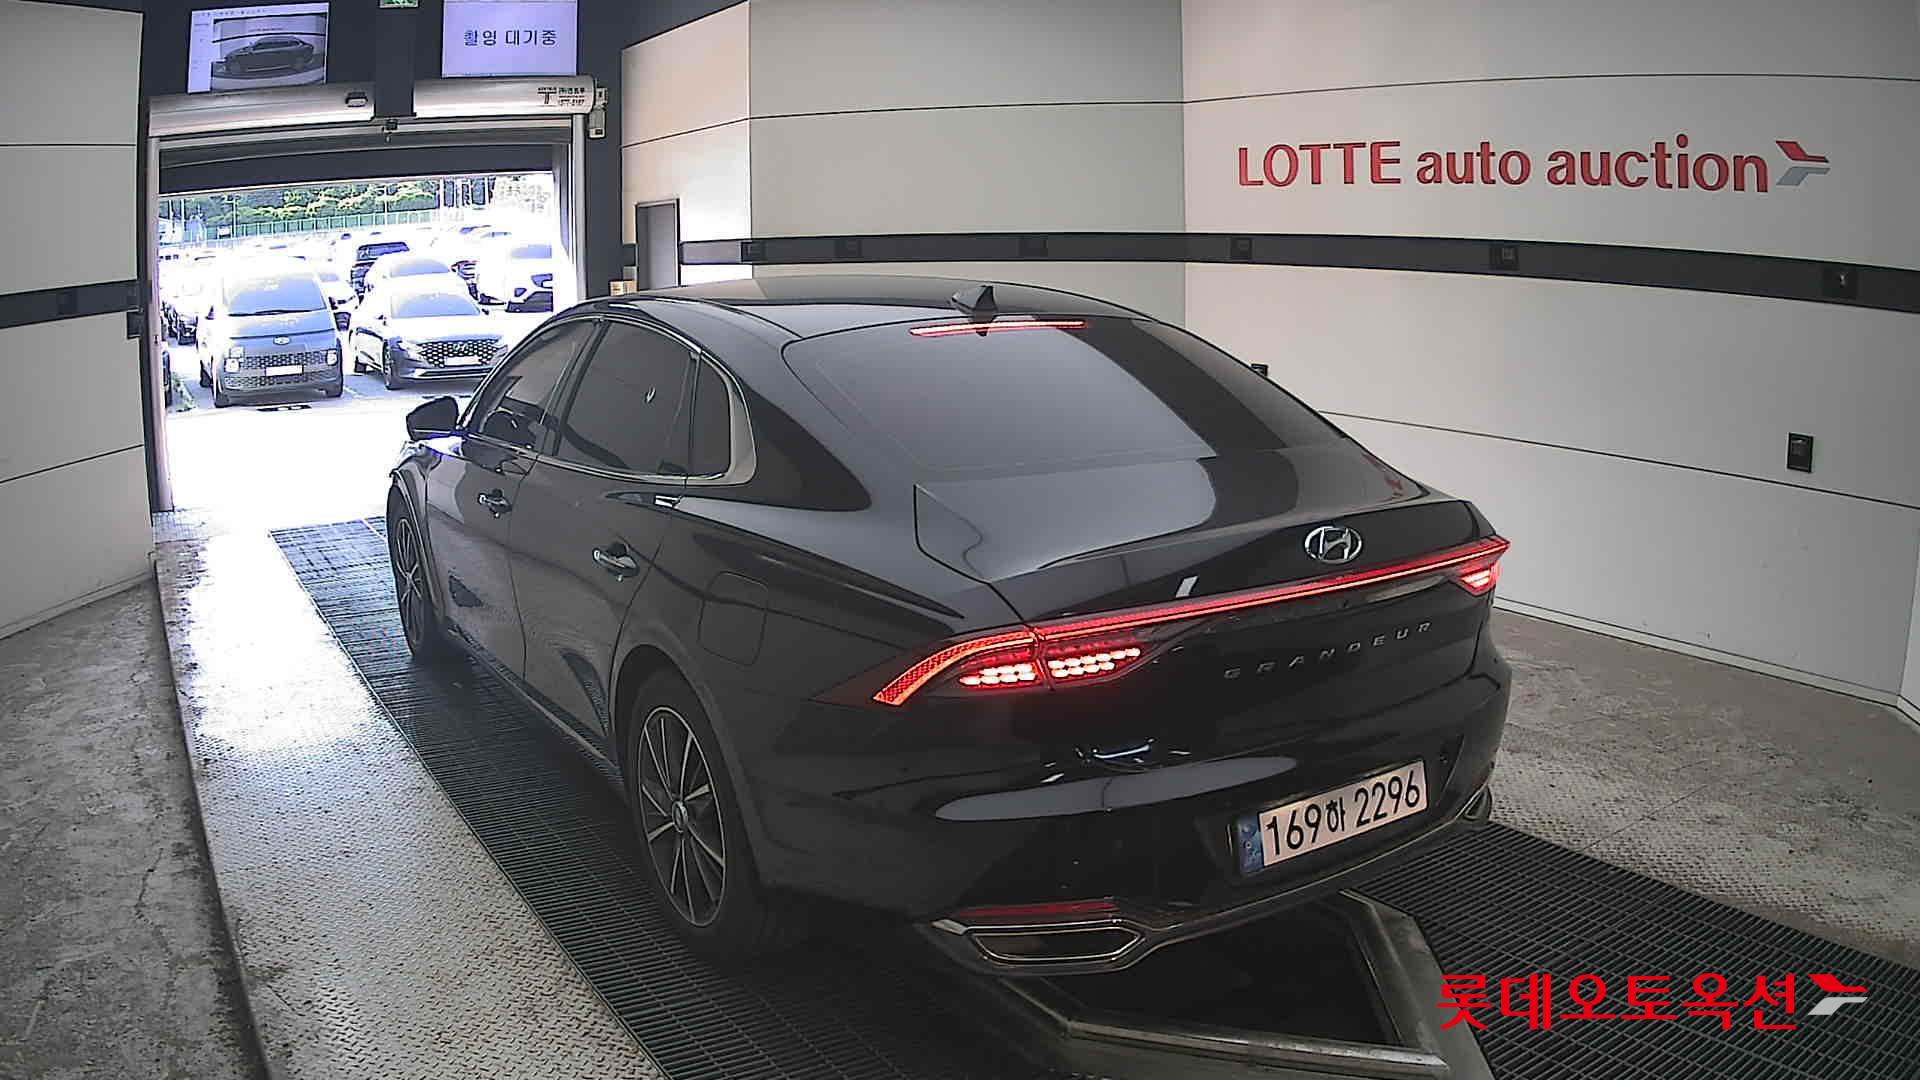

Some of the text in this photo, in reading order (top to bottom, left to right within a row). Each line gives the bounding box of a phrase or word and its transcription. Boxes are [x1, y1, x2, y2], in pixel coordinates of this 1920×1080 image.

[505, 29, 557, 46] 대기중
[1238, 133, 1768, 193] LOTTE auto auction
[1224, 621, 1433, 679] GRANDEUR
[1266, 770, 1421, 855] 169하 2296
